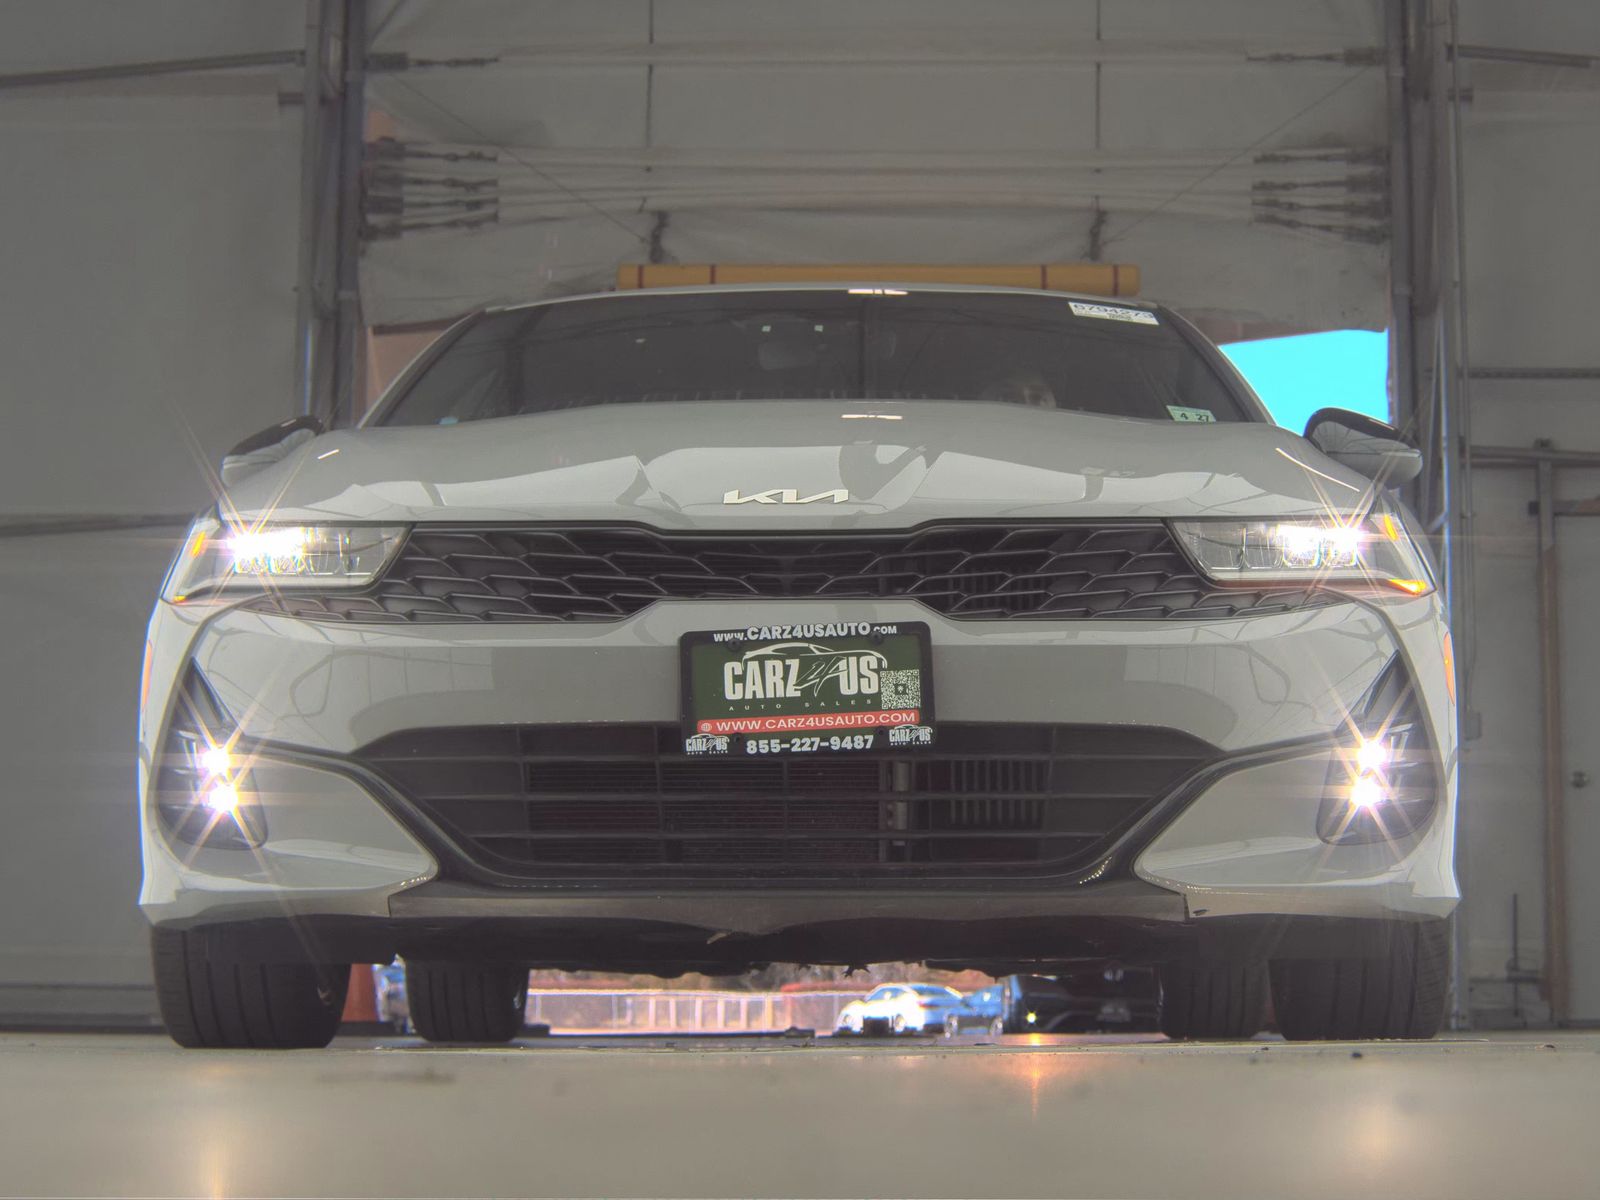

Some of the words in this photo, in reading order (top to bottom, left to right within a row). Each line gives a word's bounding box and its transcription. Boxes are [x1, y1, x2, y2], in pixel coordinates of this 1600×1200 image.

[723, 489, 849, 504] KIA
[723, 658, 801, 700] CARZ
[838, 655, 880, 696] US
[728, 703, 782, 712] AUTO
[804, 698, 872, 708] SALES
[716, 712, 915, 731] WWW.CARZ4USAUTO.COM
[746, 734, 874, 755] 855-227-9487
